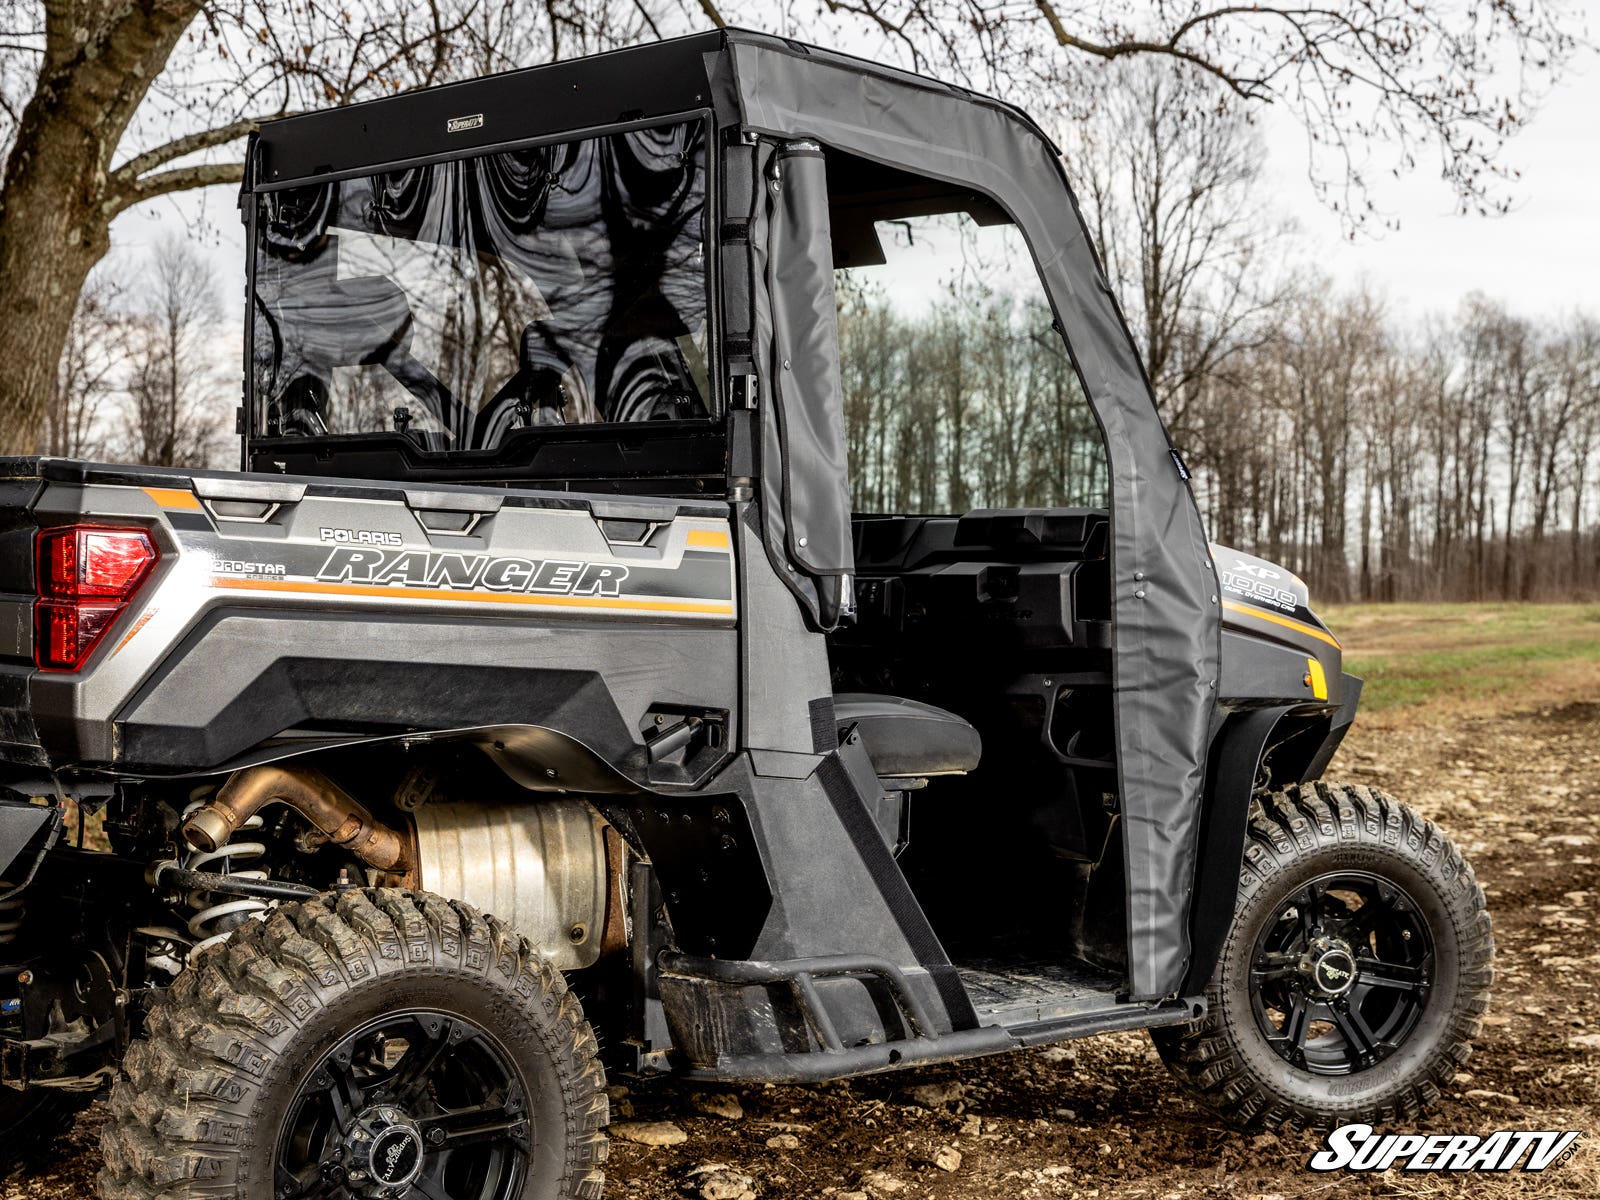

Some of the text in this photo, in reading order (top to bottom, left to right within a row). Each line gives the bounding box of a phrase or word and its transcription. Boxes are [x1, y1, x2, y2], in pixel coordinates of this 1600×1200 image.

[320, 528, 402, 545] POLARIS
[213, 560, 286, 575] PROSTAR
[316, 546, 629, 596] RANGER
[1232, 559, 1280, 580] XP
[1222, 571, 1297, 607] 1000
